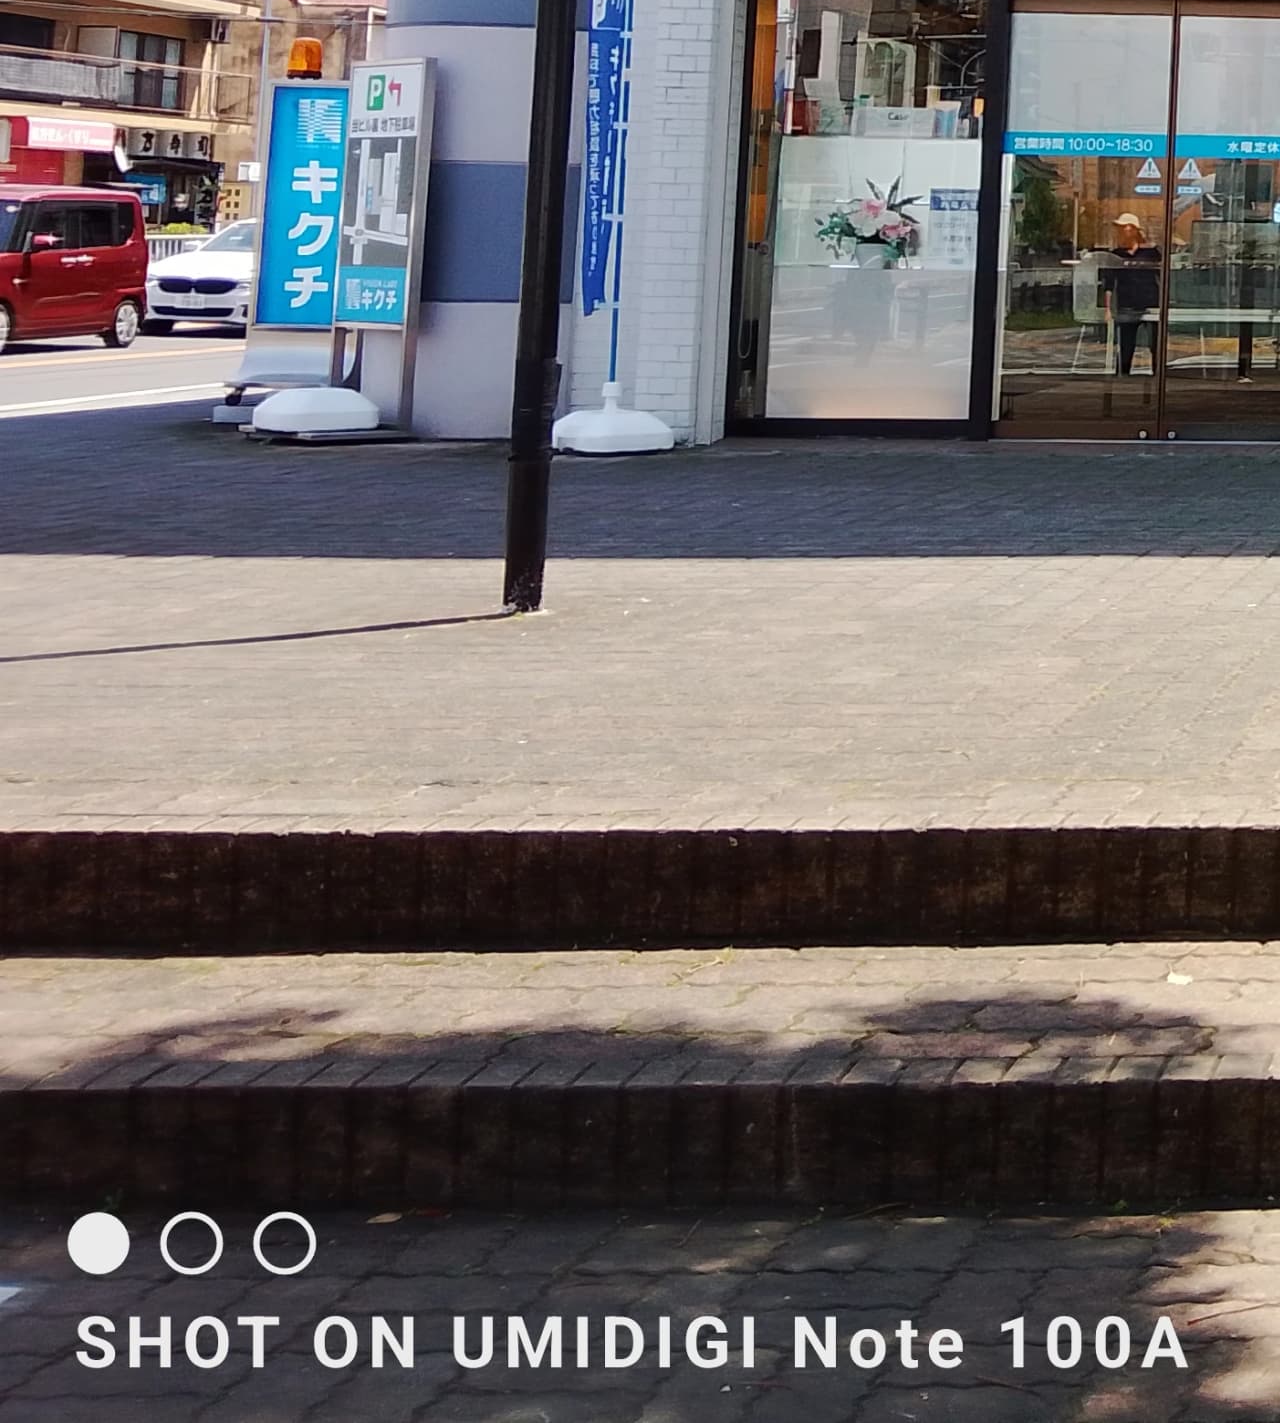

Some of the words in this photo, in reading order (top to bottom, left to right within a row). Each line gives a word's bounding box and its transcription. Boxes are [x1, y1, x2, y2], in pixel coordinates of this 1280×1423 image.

[369, 78, 383, 108] P
[1014, 137, 1065, 151] 営業時間
[1227, 141, 1280, 154] 水曜定休
[284, 160, 338, 309] キクチ
[361, 288, 397, 311] キクチ
